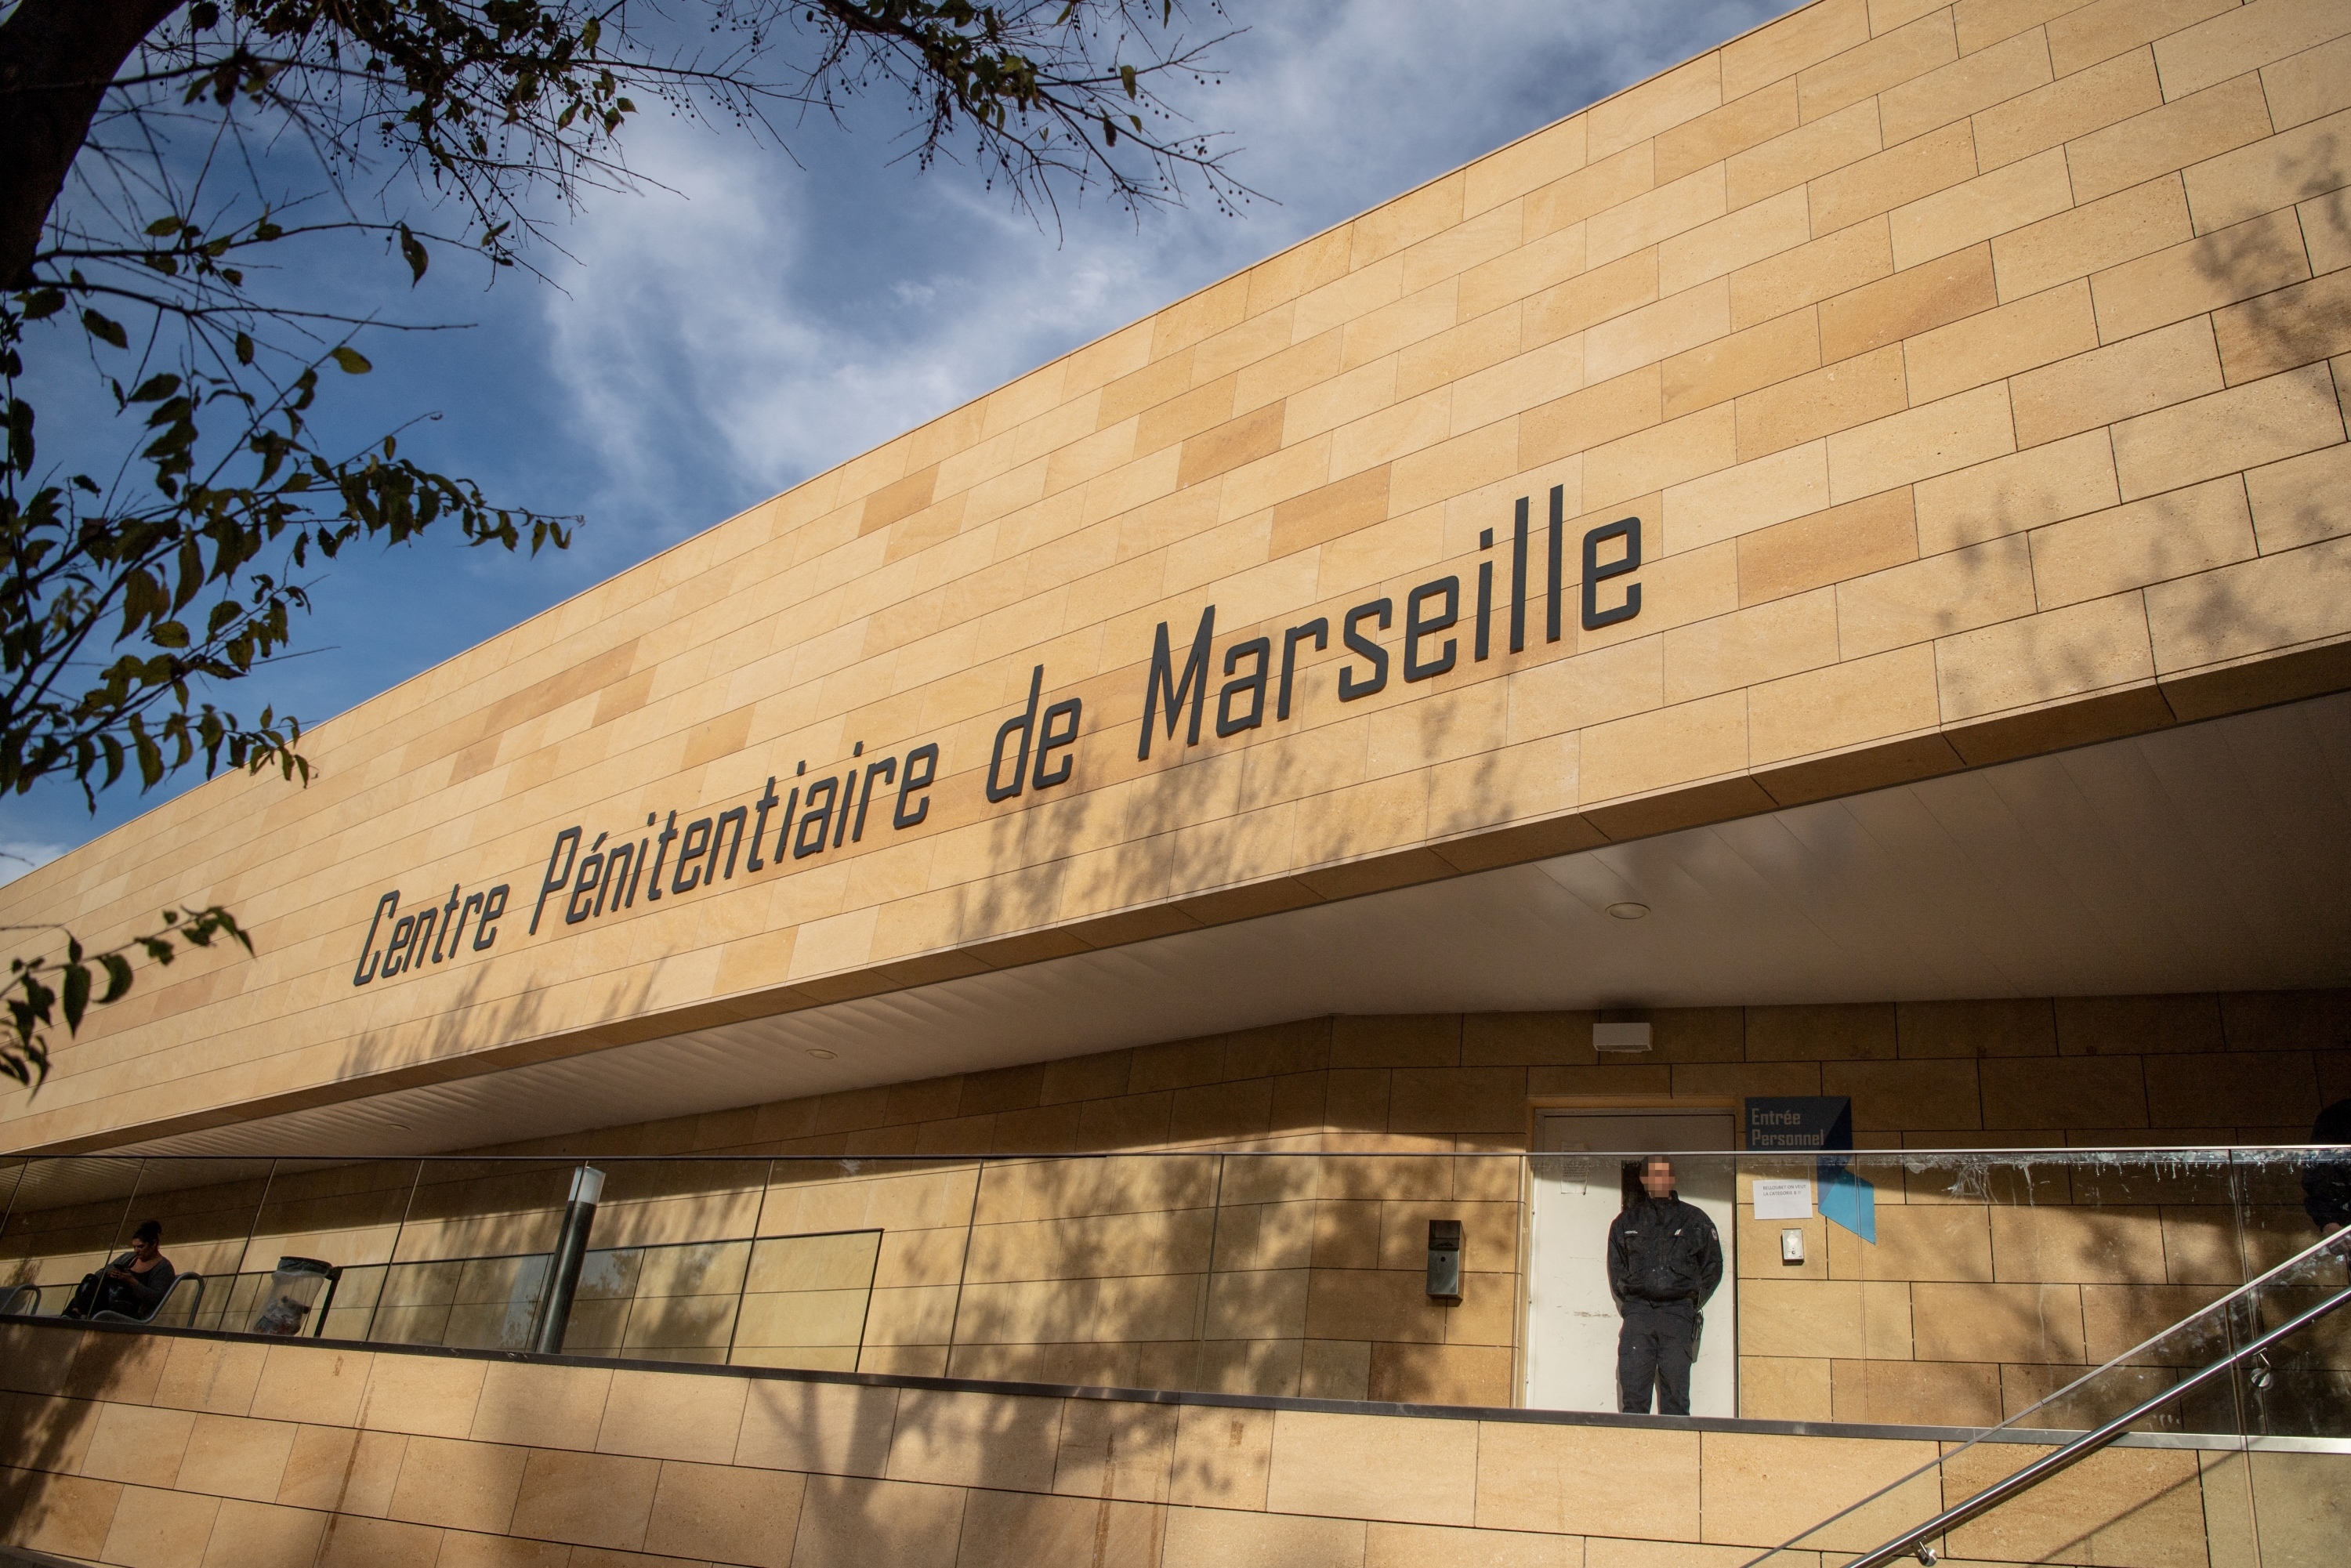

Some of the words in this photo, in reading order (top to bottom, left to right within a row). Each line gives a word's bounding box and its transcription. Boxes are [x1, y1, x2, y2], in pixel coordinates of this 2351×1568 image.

[353, 884, 509, 987] Centre
[529, 741, 938, 936] Pénitentiaire
[986, 664, 1081, 803] de
[1138, 484, 1641, 762] Marseille
[1751, 1108, 1801, 1125] Entrée
[1751, 1129, 1824, 1146] Personnel
